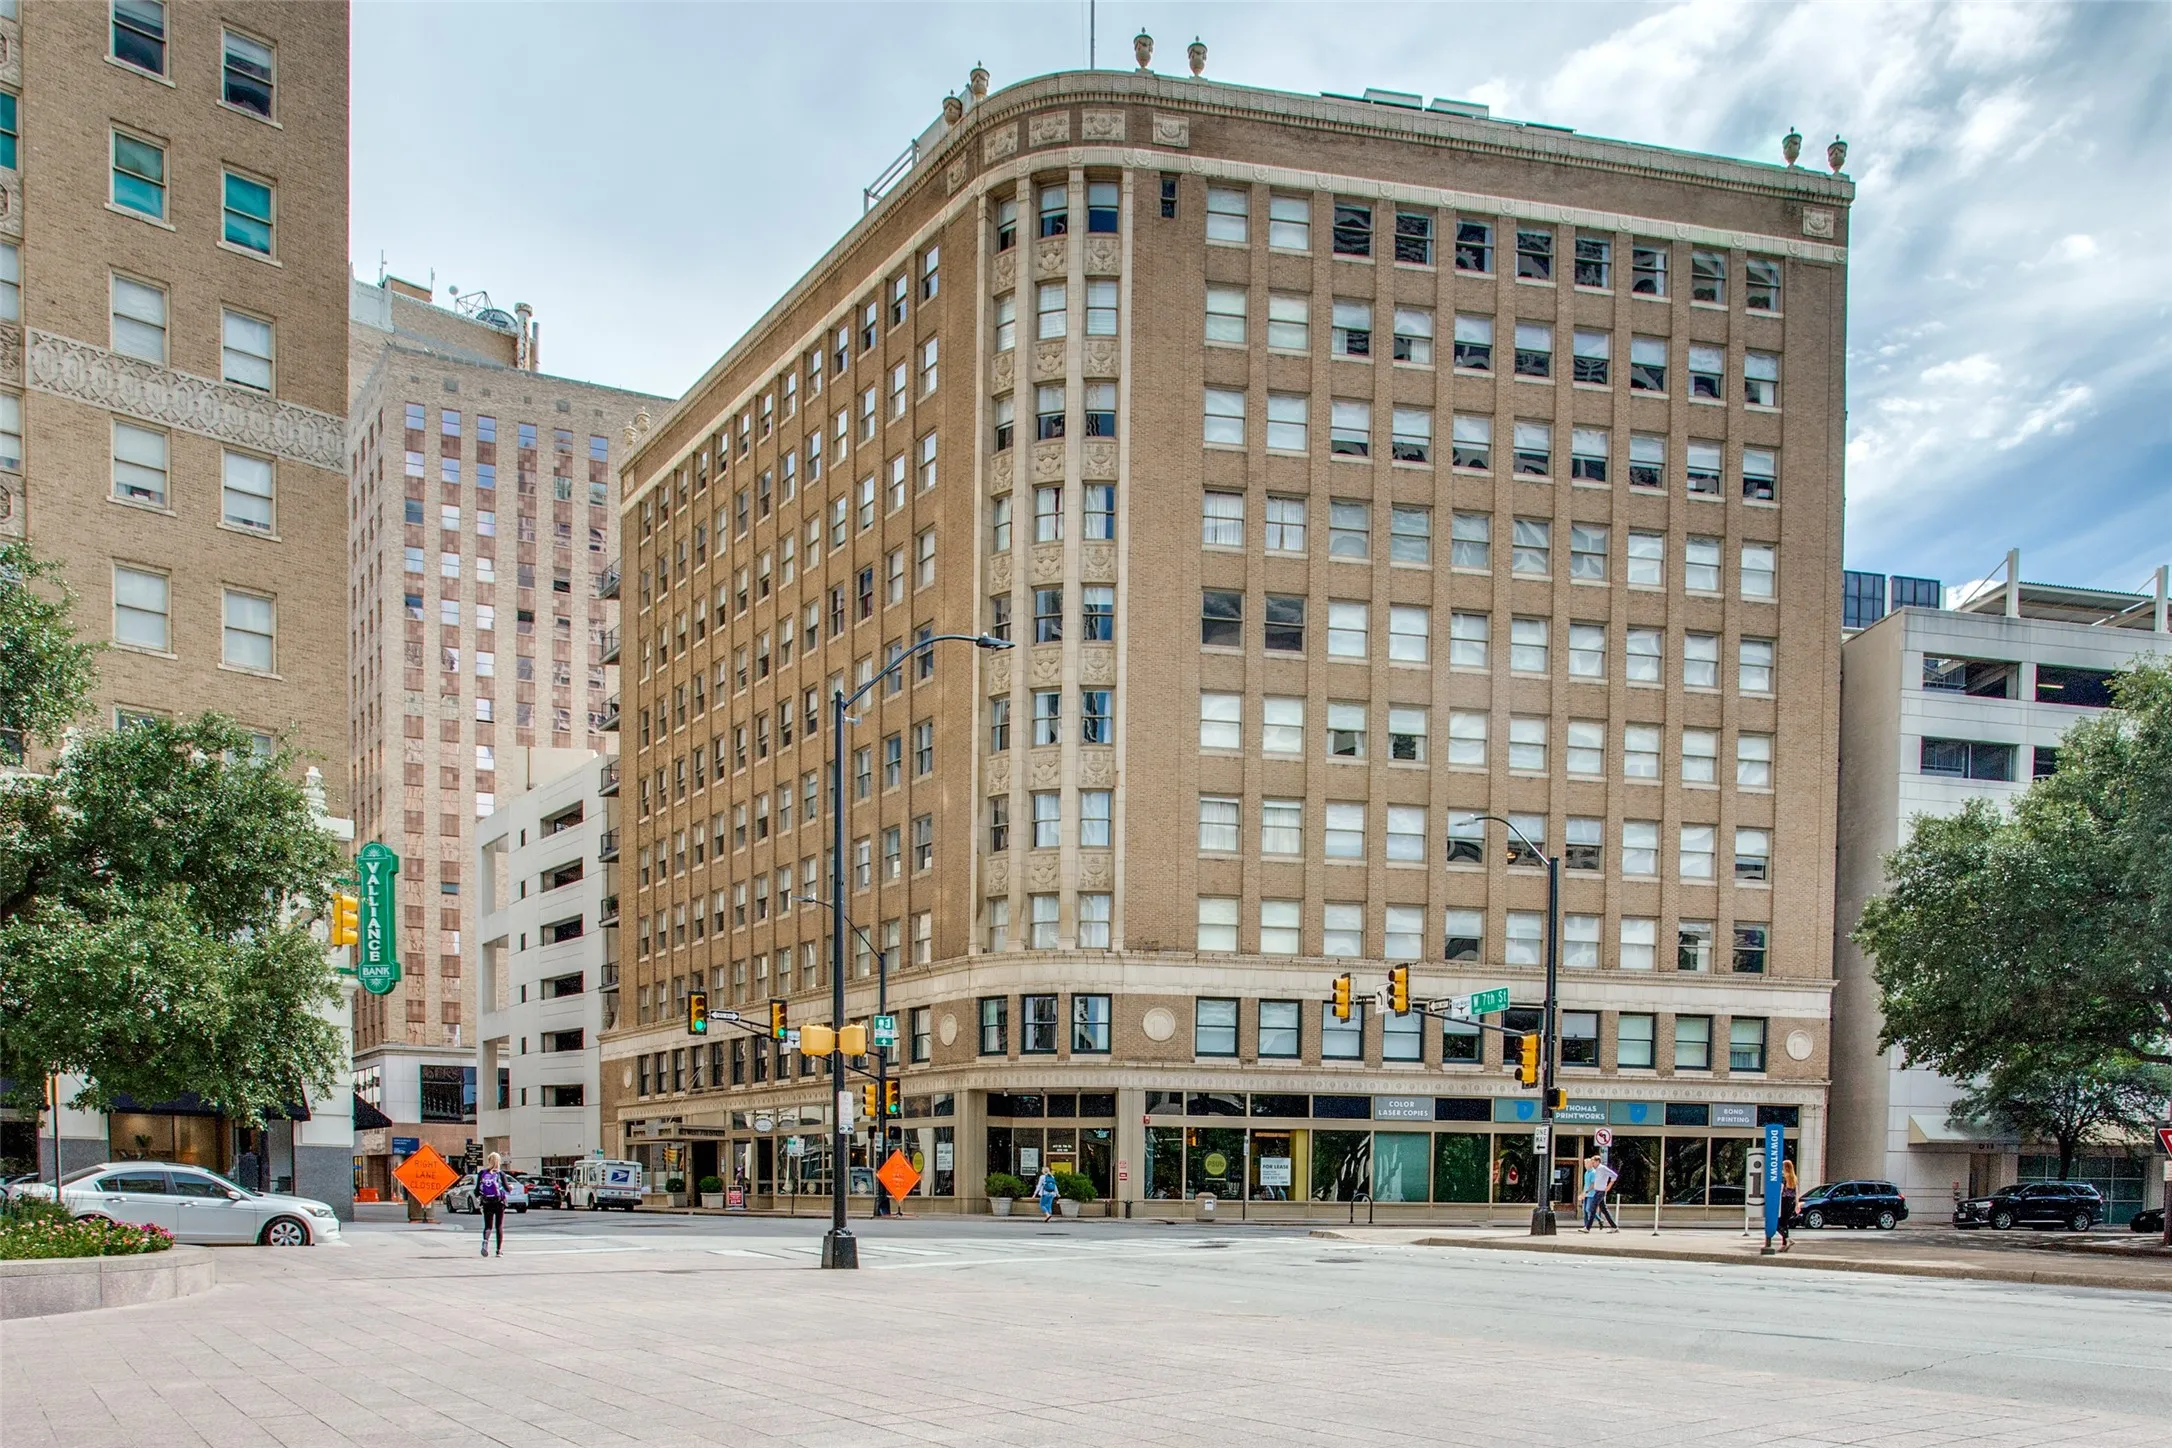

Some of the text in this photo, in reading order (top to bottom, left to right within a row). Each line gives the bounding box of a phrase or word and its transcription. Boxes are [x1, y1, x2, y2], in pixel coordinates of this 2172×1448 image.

[366, 861, 381, 962] VALLIANCE
[362, 967, 390, 976] BANK
[1473, 990, 1507, 1007] W 7th St
[1378, 1109, 1401, 1117] LASER
[1555, 1112, 1605, 1120] PRINTWORKS
[1716, 1116, 1750, 1124] PRINTING
[1536, 1128, 1547, 1136] ONE
[1535, 1136, 1547, 1144] WAY
[1770, 1129, 1779, 1182] DOWNTOWN
[414, 1159, 438, 1169] RIGHT
[415, 1172, 436, 1180] LANE
[410, 1181, 441, 1190] CLOSED
